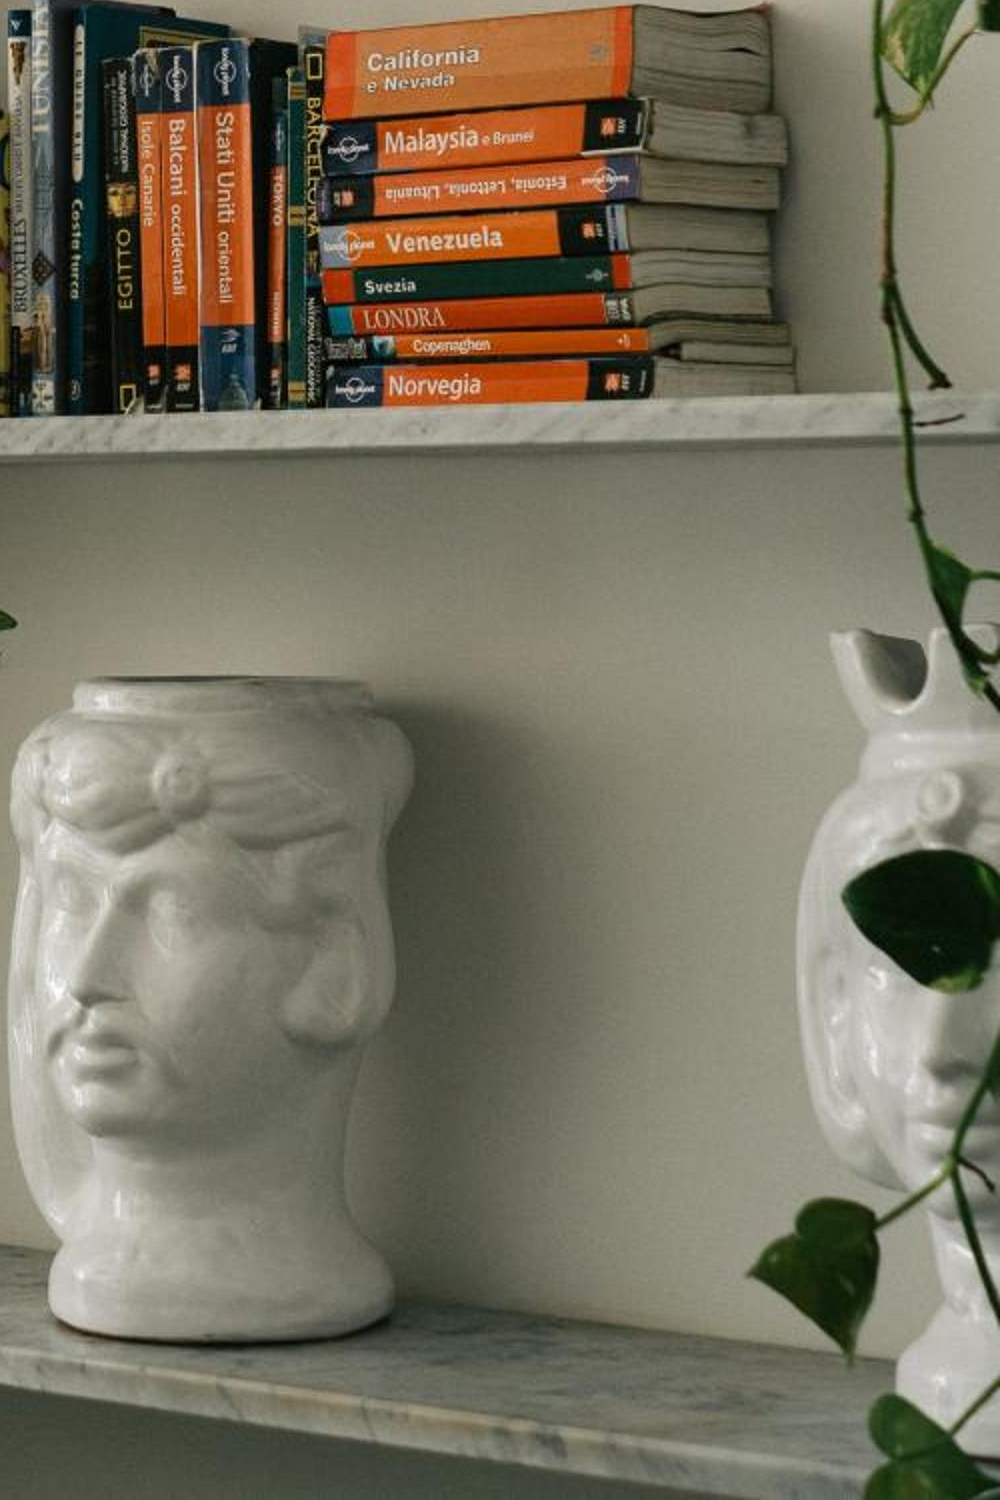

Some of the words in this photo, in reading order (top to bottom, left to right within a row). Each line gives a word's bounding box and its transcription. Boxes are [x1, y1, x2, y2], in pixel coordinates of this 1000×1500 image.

[367, 45, 481, 71] California
[367, 80, 377, 92] e
[384, 72, 455, 92] Nevada
[140, 120, 153, 163] Isole
[168, 118, 185, 196] Balcani
[215, 112, 234, 165] Stati
[385, 126, 480, 156] Malaysia
[493, 130, 534, 145] Brunei
[141, 166, 154, 227] Canarie
[216, 172, 235, 225] Uniti
[272, 173, 284, 227] TOKYO
[385, 184, 441, 202] Lituania
[444, 179, 508, 197] Lettonia,
[511, 175, 568, 193] Estonia,
[71, 198, 84, 249] Costa
[385, 225, 503, 252] Venezuela
[13, 218, 27, 313] BRUXELLES
[116, 228, 132, 310] EGITTO
[169, 202, 185, 296] occidentali
[216, 231, 234, 304] orientali
[71, 253, 83, 299] turca
[365, 278, 417, 294] Svezia
[363, 306, 446, 329] LONDRA
[413, 337, 491, 353] Copenaghen
[388, 376, 481, 397] Norvegia
